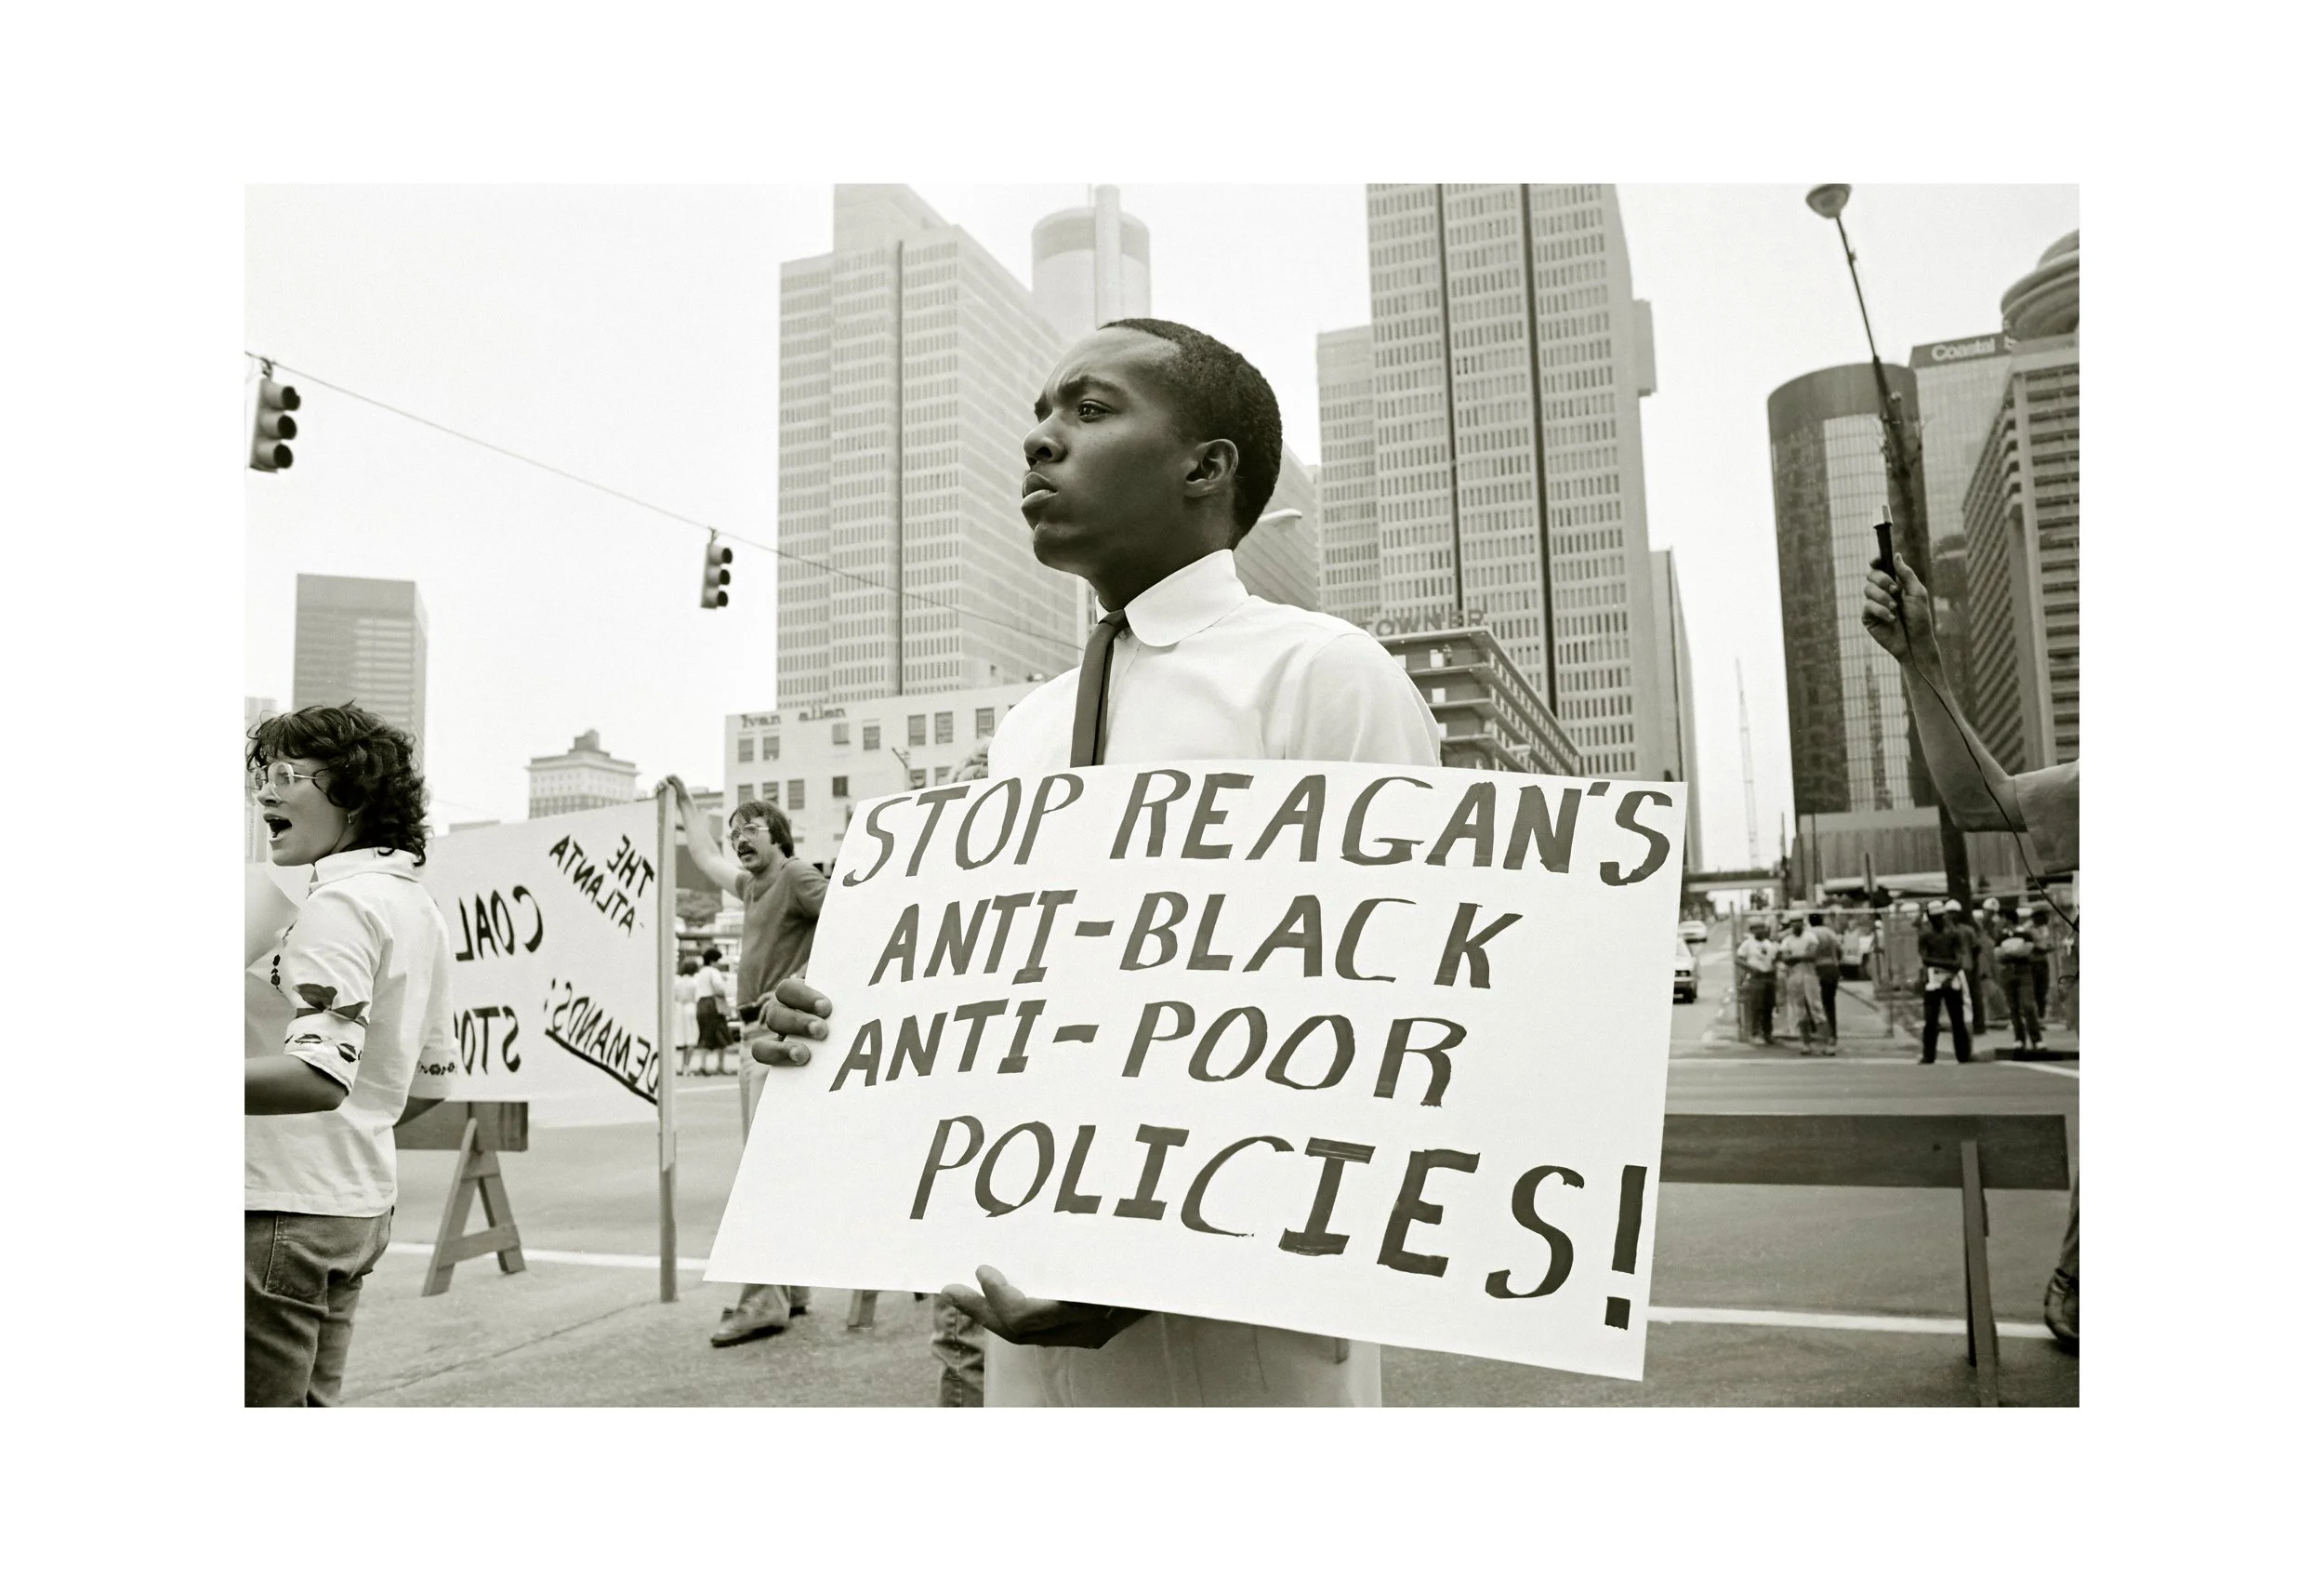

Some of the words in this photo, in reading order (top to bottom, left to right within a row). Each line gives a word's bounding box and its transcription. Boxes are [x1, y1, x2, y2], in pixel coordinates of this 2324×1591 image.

[841, 772, 1085, 888] STOP
[1109, 768, 1673, 887] REAGAN'S
[867, 889, 1524, 990] ANTI-BLACK
[909, 1115, 1648, 1332] POLICIES!
